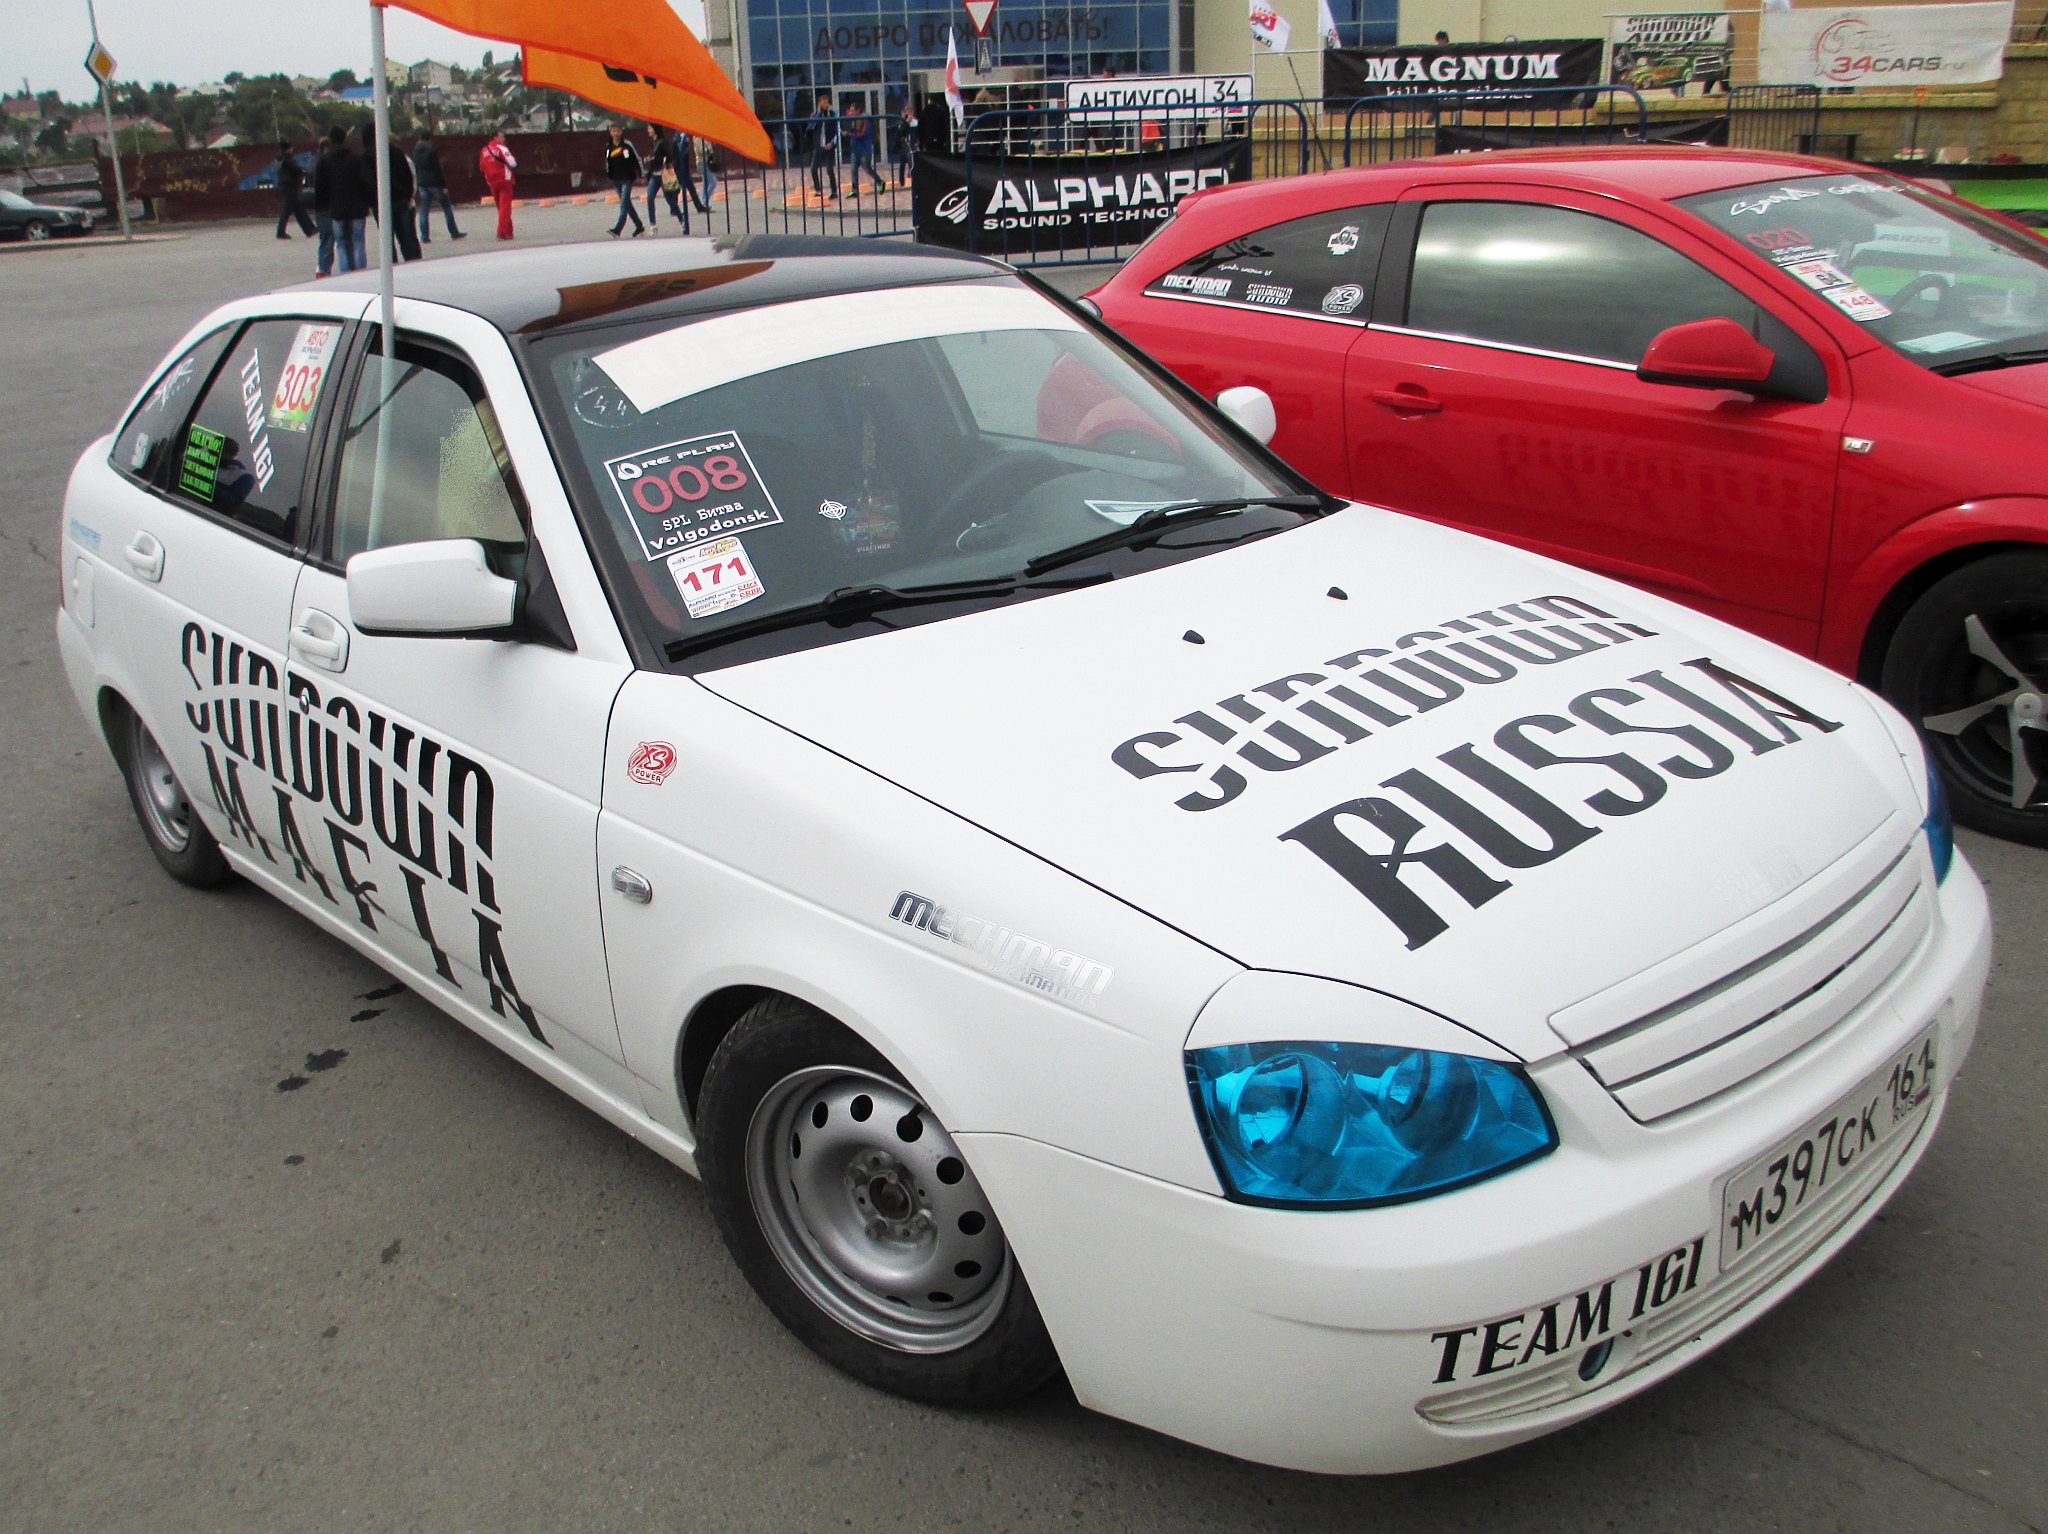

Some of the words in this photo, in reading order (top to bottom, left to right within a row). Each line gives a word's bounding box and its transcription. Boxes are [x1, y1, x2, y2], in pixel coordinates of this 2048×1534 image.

[815, 24, 909, 53] ДОБРО
[919, 17, 1110, 49] ПОЖАЛОВАТЬ!
[1363, 53, 1561, 82] MAGNUM
[1080, 87, 1197, 108] АНТИУГОН
[1212, 79, 1238, 103] 34
[1385, 87, 1417, 97] kill
[983, 212, 1072, 232] SOUND
[1079, 205, 1177, 224] TECHNO
[1161, 275, 1233, 291] MECHMAN
[1245, 283, 1294, 300] SUNDOWN
[1245, 294, 1290, 306] AUDIO
[1839, 295, 1876, 309] 148
[241, 347, 266, 444] TEAM
[275, 363, 323, 413] 303
[190, 430, 222, 454] ОПАСНО!
[641, 455, 672, 469] RE
[676, 441, 736, 460] PLAY
[632, 455, 748, 513] 008
[649, 509, 770, 551] Volgodonsk
[662, 514, 691, 532] SPL
[696, 502, 745, 521] Битва
[682, 556, 747, 592] 171
[1111, 595, 1660, 812] SUNDOWN
[181, 621, 502, 929] SUNDOWN
[634, 768, 661, 783] POWER
[1276, 656, 1845, 951] RUSSIA
[200, 740, 555, 1050] MAFIA
[1730, 1097, 1878, 1251] М397СК
[1886, 1038, 1935, 1109] 161
[1431, 1280, 1617, 1384] TEAM
